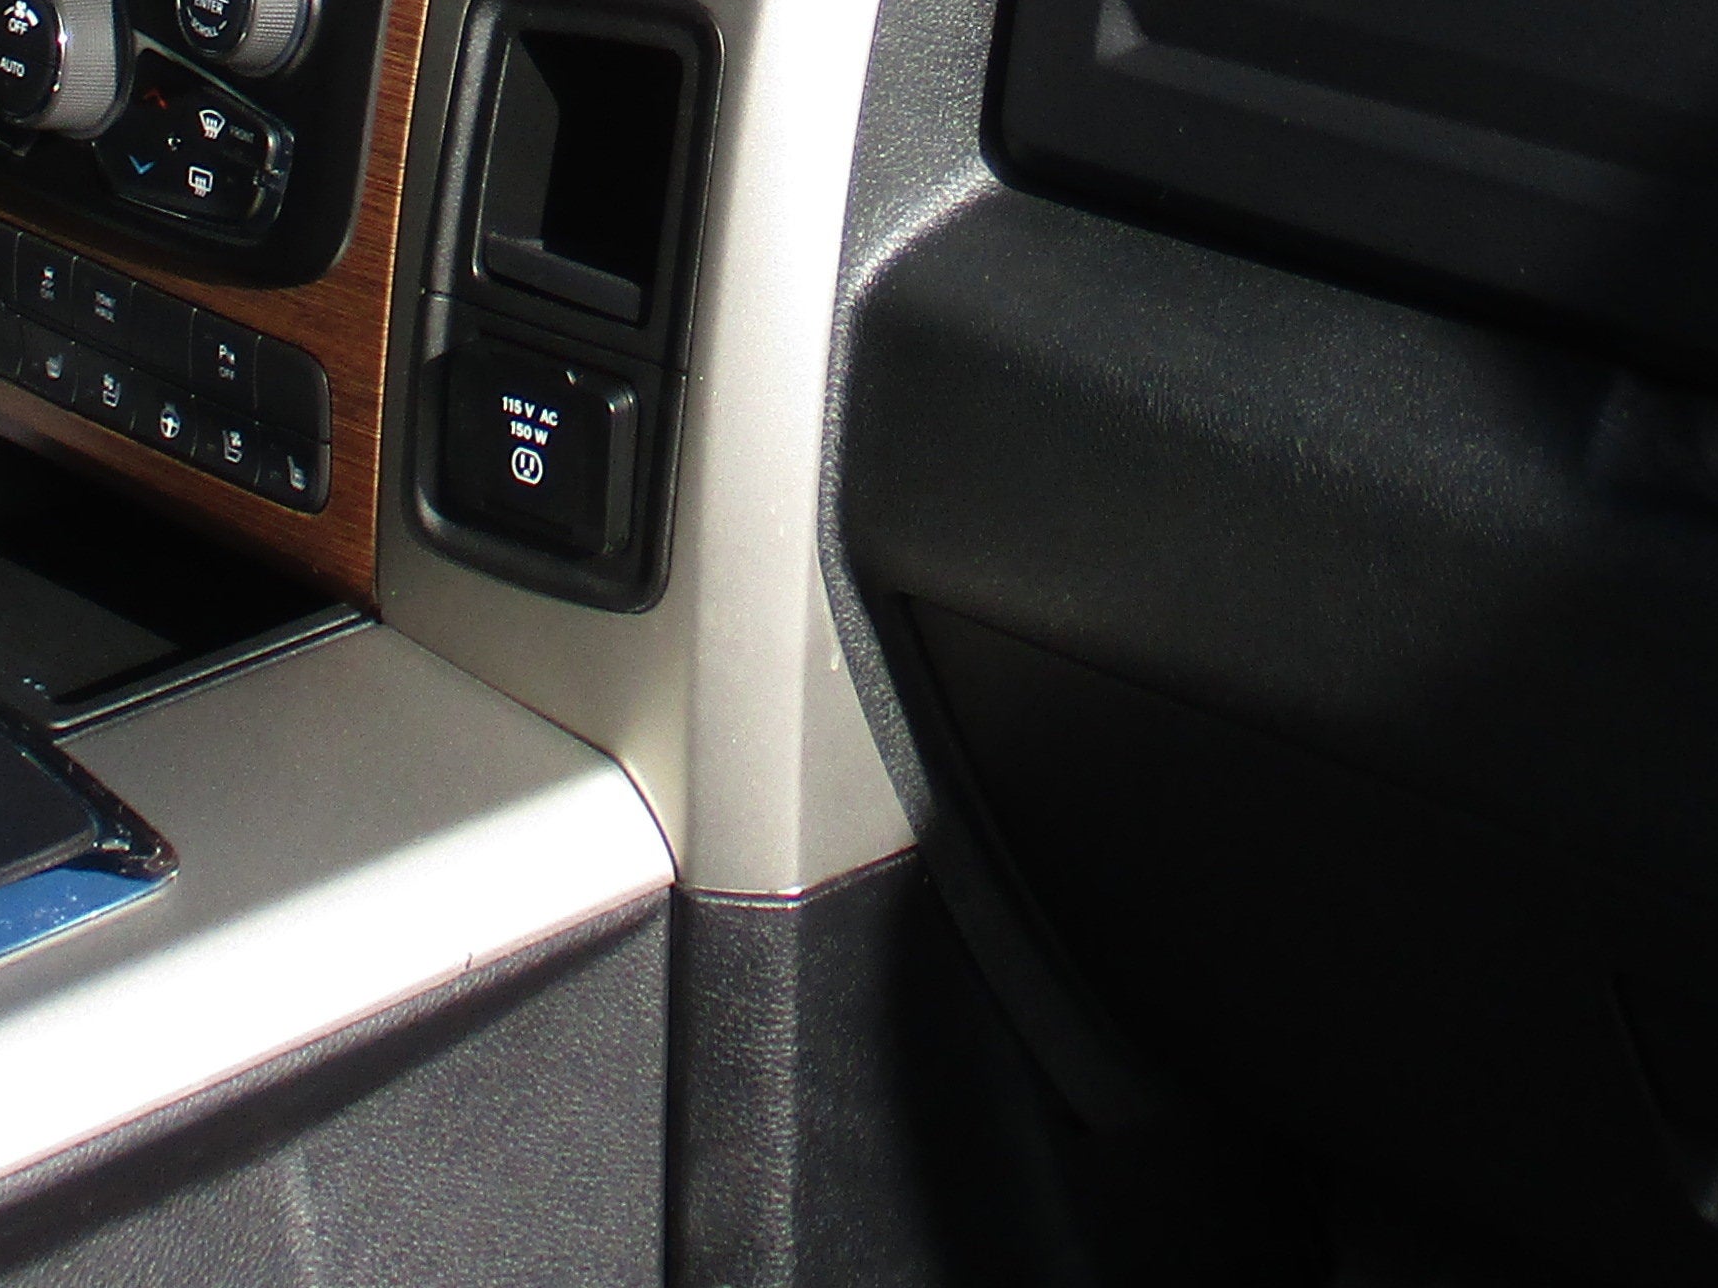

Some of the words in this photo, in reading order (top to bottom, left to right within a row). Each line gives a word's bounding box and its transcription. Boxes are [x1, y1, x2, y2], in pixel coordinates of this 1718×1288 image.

[7, 17, 29, 36] OFF
[501, 395, 523, 415] 115
[524, 402, 536, 419] V
[539, 408, 559, 427] AC
[510, 420, 533, 441] 150
[534, 427, 549, 446] W
